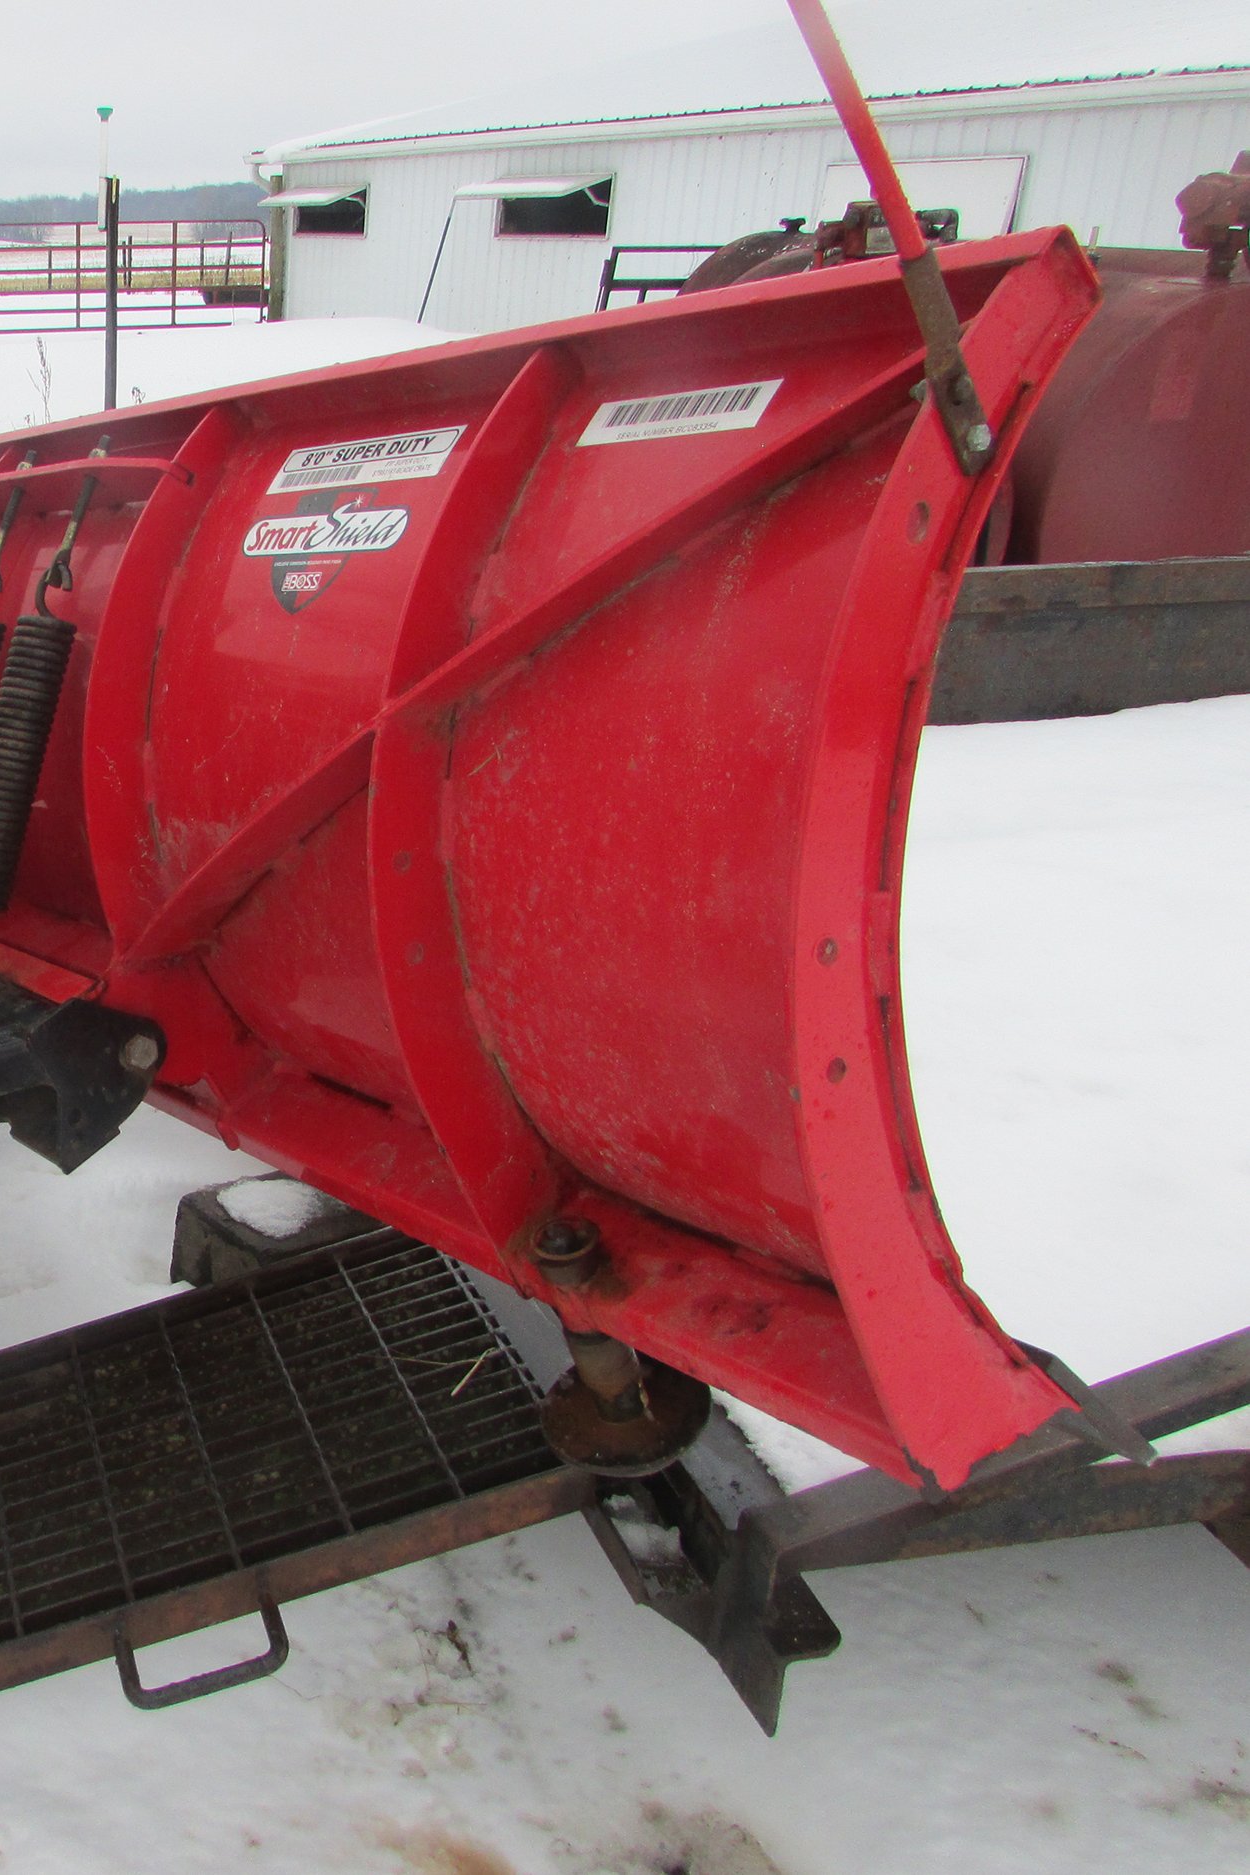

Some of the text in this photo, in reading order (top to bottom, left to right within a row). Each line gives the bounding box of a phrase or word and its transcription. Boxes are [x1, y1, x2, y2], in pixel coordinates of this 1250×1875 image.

[333, 443, 387, 463] SUPER
[386, 435, 437, 456] DUTY
[290, 574, 321, 590] BOSS
